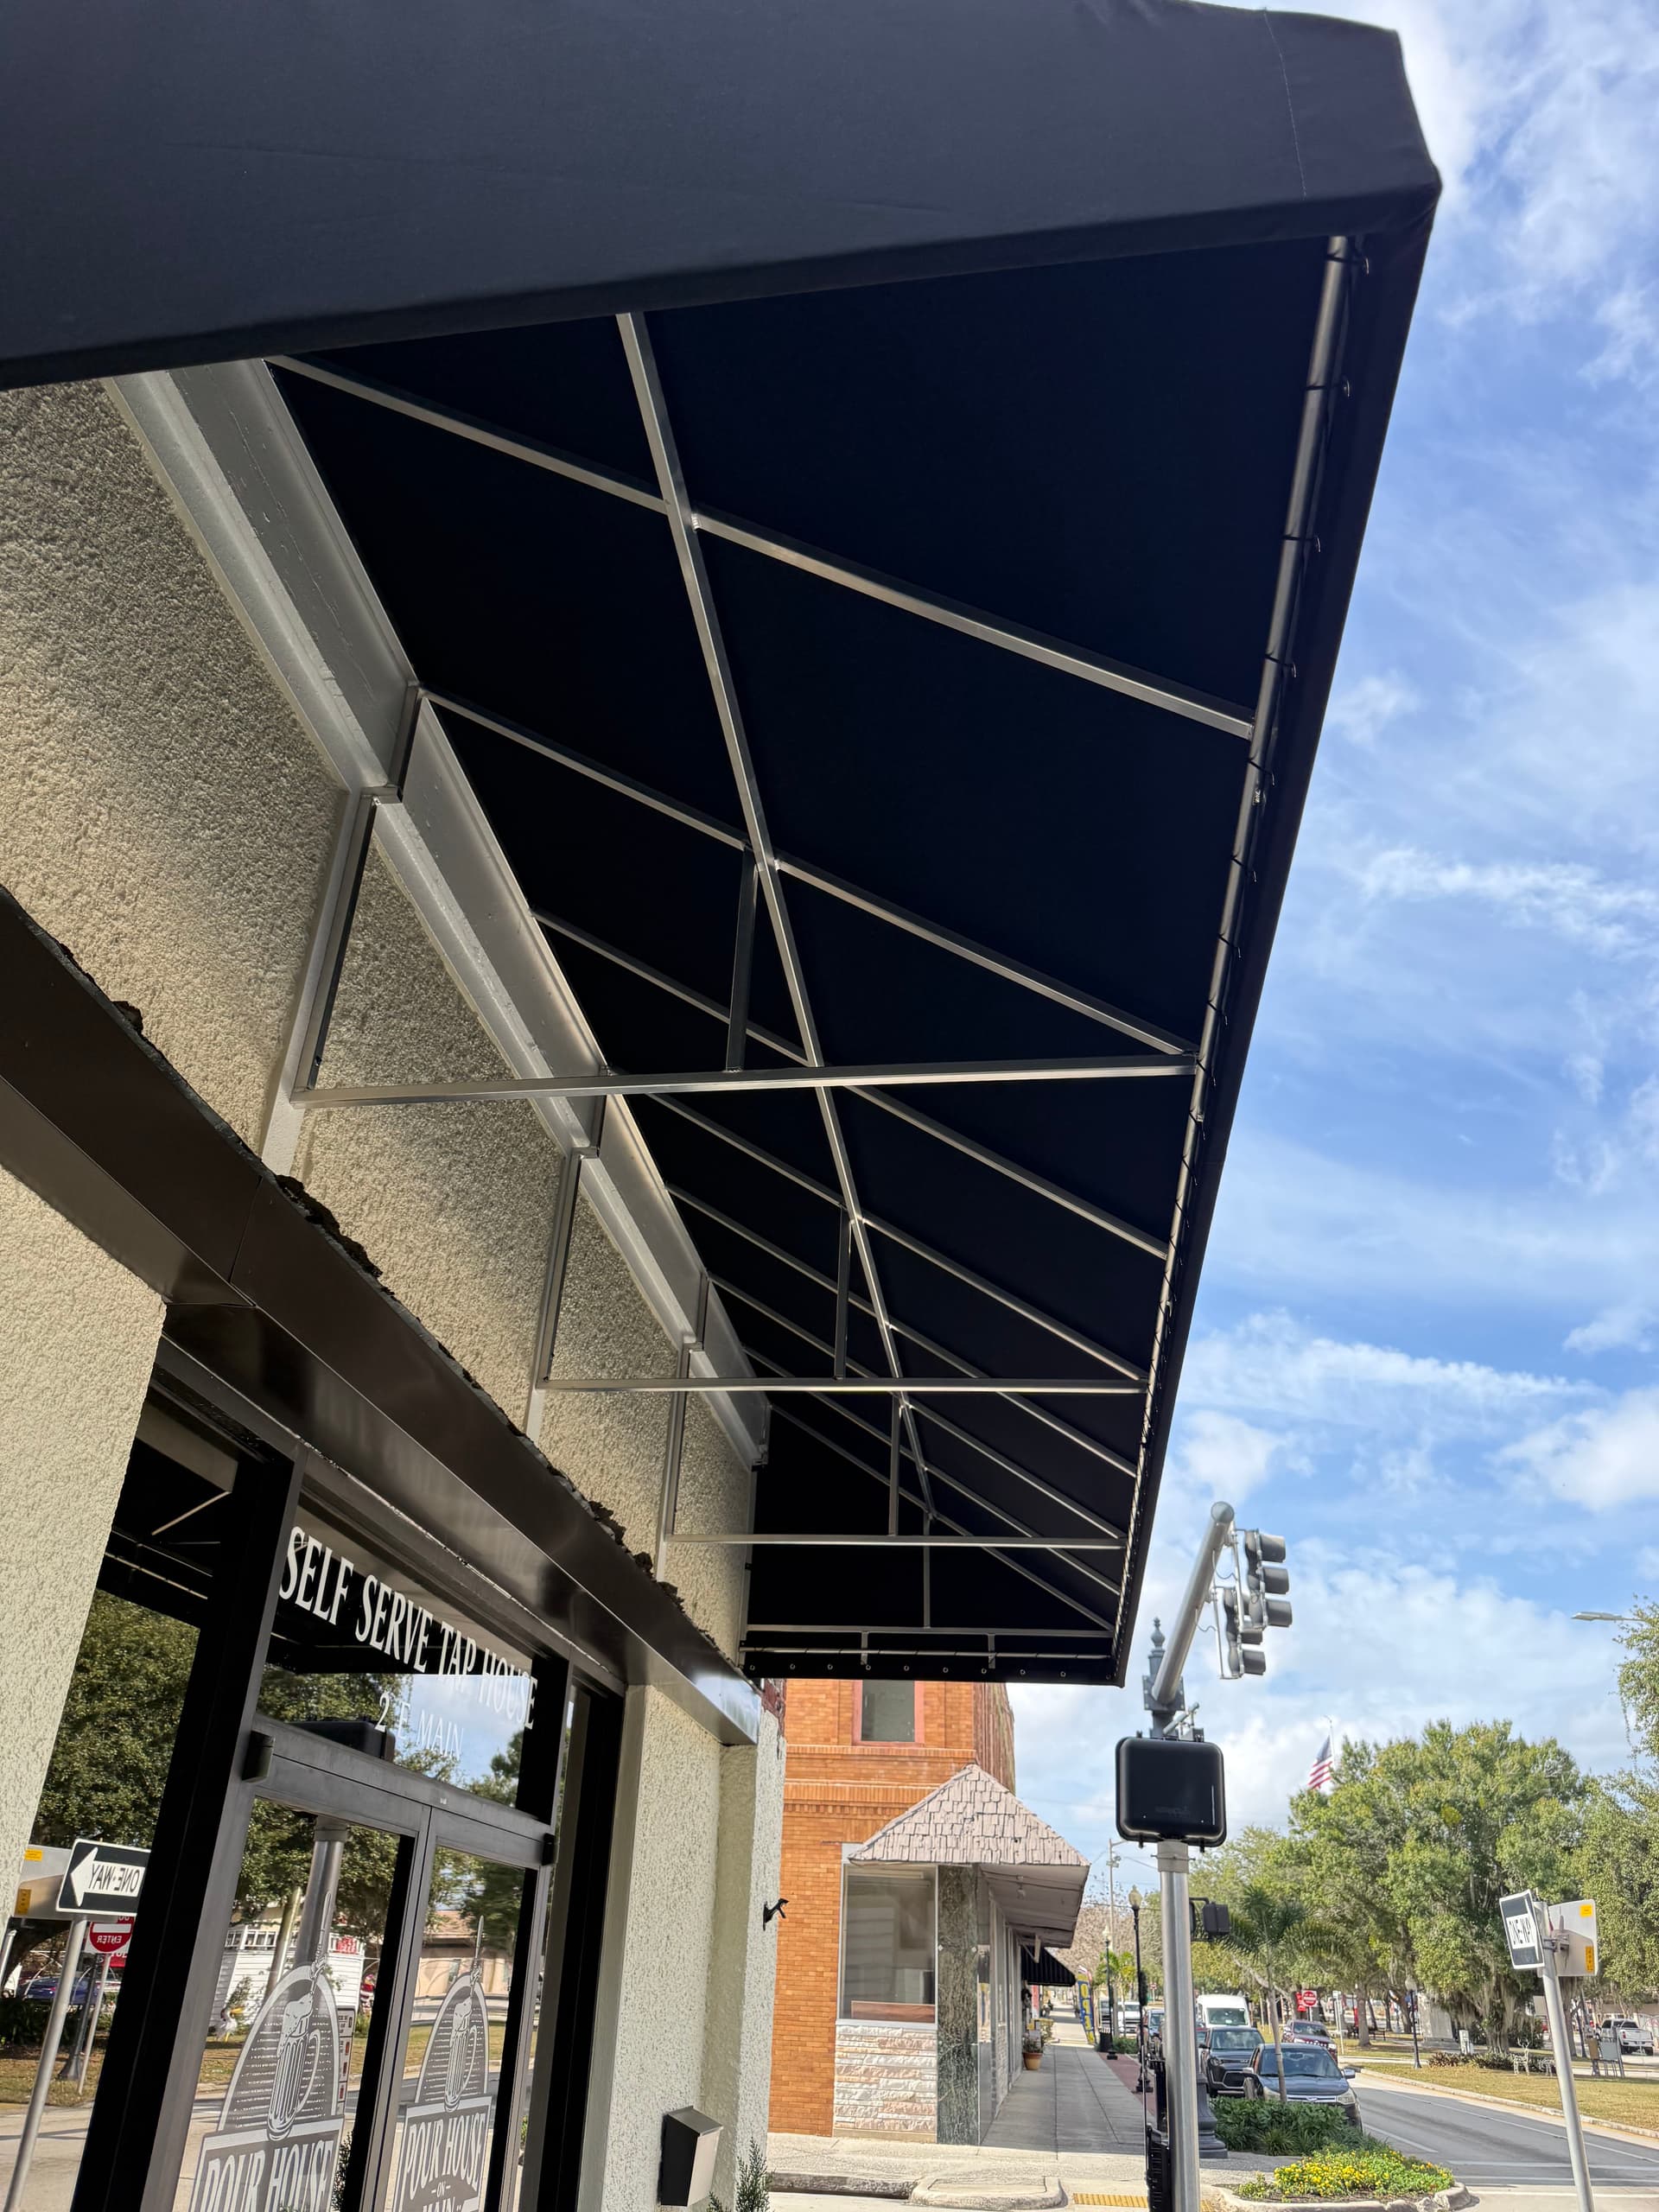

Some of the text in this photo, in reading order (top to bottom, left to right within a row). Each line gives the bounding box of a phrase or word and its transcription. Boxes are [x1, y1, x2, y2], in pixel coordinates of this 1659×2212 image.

[279, 1526, 538, 1730] SELF SERVE TAP HOUSE
[374, 1691, 464, 1761] 2 E MAIN
[264, 2139, 334, 2212] HOUSE
[399, 2113, 486, 2212] POUR HOUSE
